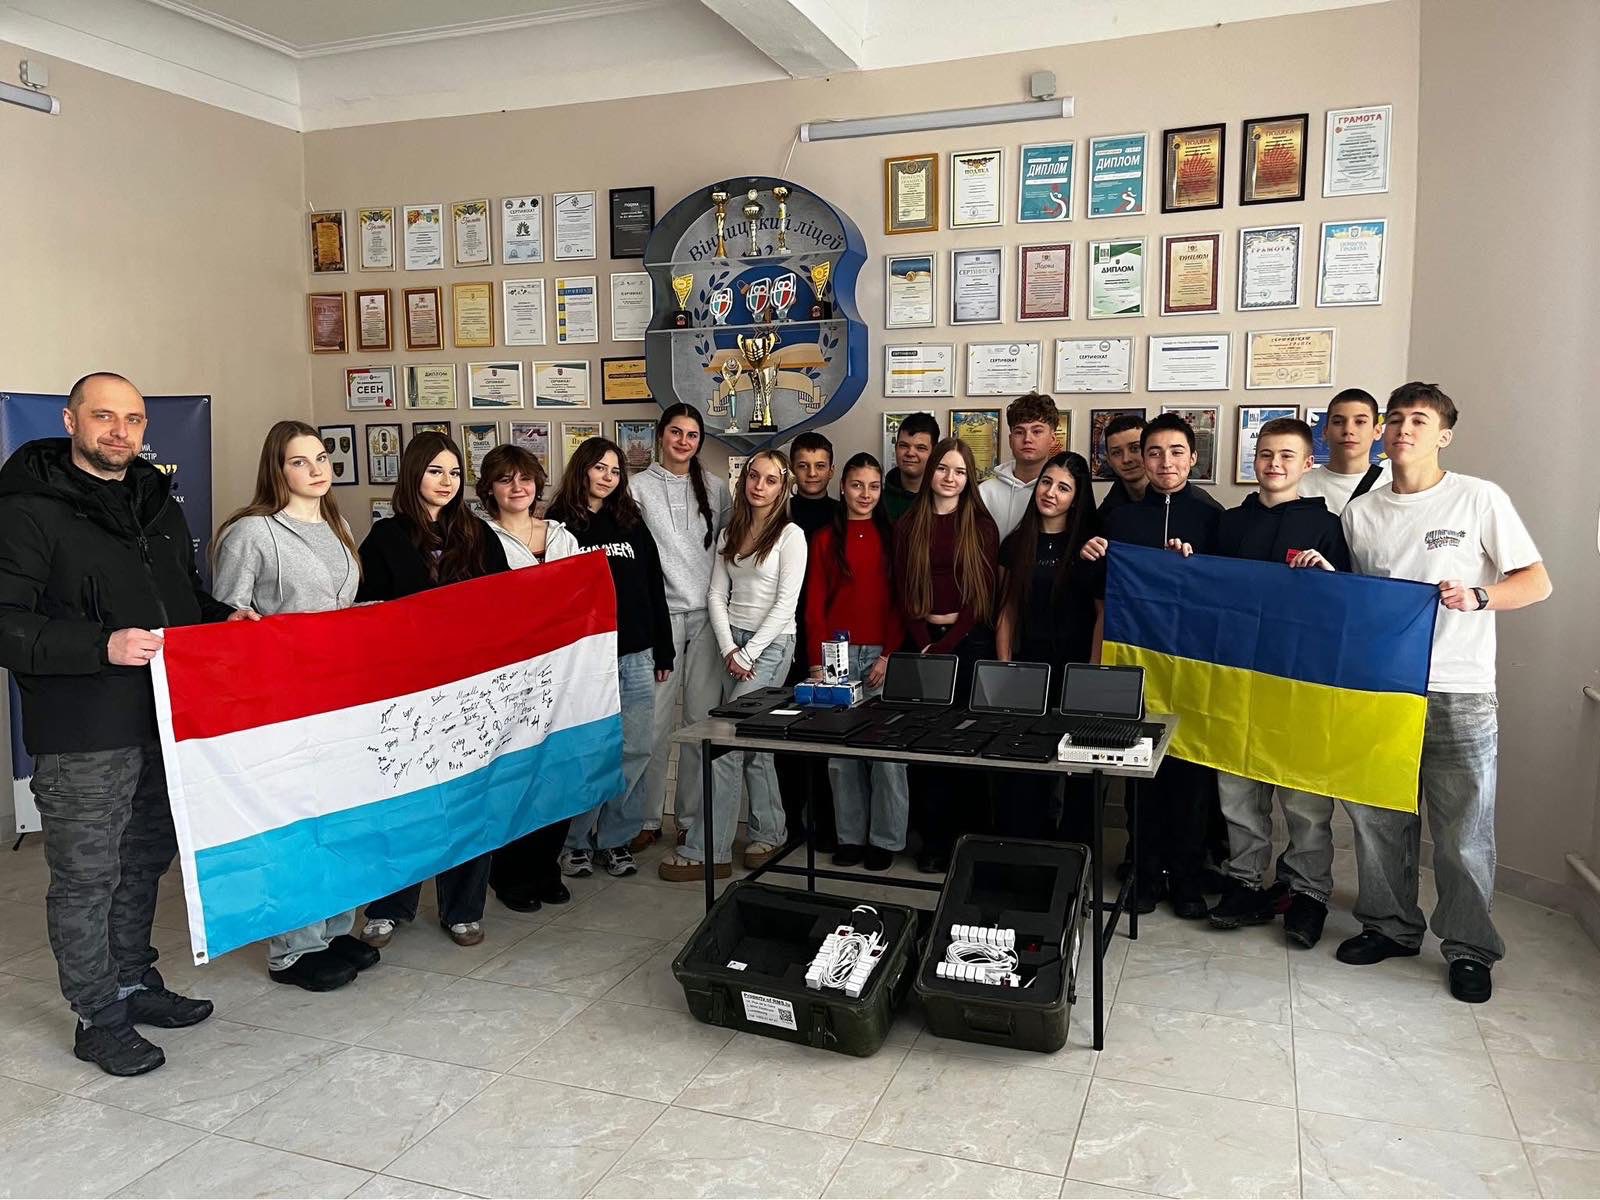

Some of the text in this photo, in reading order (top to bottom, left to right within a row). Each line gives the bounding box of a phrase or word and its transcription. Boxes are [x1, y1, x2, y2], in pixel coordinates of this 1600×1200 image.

[1338, 114, 1382, 124] ГРАМОТА
[1096, 155, 1140, 171] ДИПЛОМ
[1027, 162, 1067, 178] ДИПЛОМ
[794, 220, 844, 251] ліцей
[958, 267, 997, 276] СЕРТИФІКАТ
[1101, 265, 1135, 274] ДИПЛОМ
